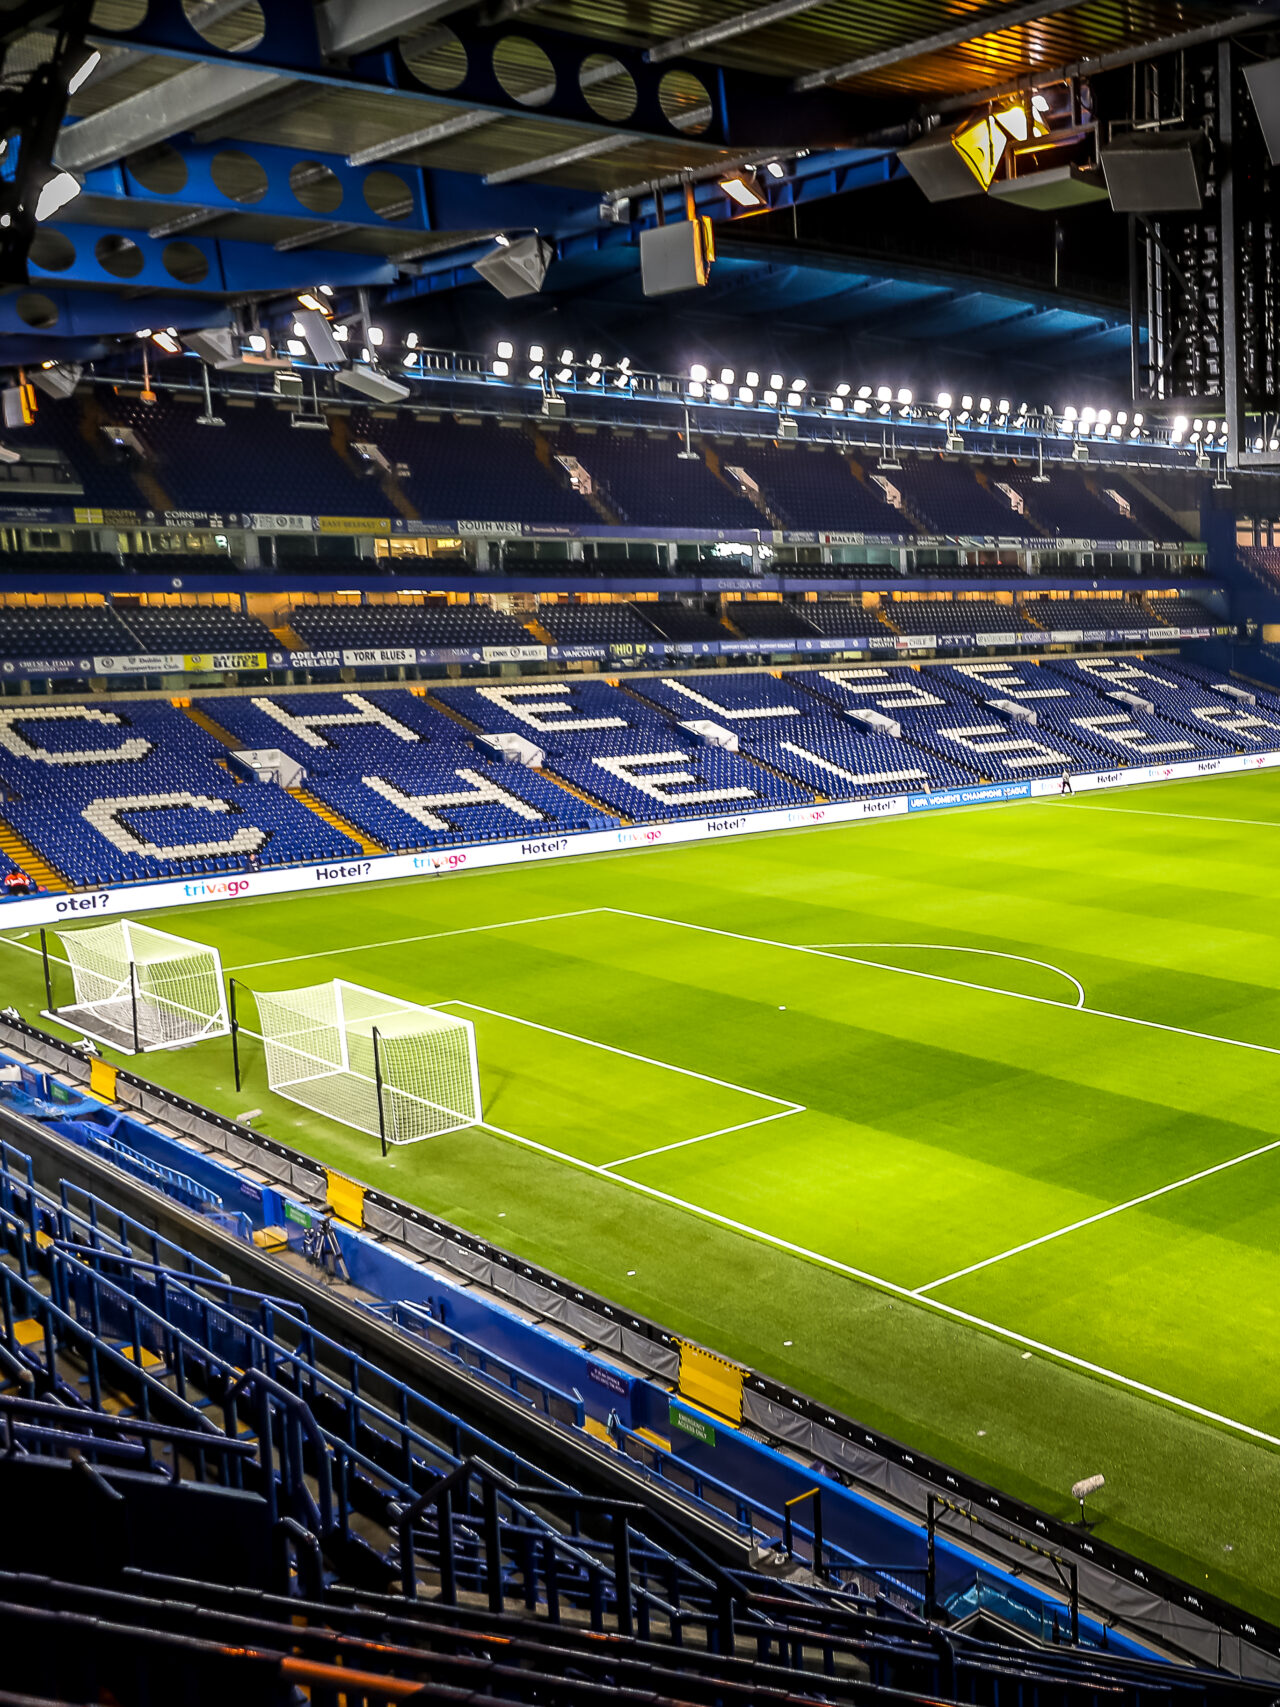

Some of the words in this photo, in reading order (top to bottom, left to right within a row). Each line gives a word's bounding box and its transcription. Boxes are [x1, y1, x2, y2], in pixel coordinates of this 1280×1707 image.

[164, 511, 208, 519] CORNISH
[165, 519, 195, 528] BLUES
[459, 520, 492, 531] SOUTH
[495, 521, 521, 532] WEST
[831, 535, 856, 543] MALTA
[289, 651, 341, 660] ADELAIDE
[353, 651, 377, 661] YORK
[380, 650, 407, 661] BLUES
[562, 649, 606, 658] VANCOUVER
[610, 643, 633, 655] OHIO
[213, 654, 259, 662] SAFFRON
[213, 660, 260, 669] BLUES
[292, 659, 340, 668] CHELSEA
[911, 796, 929, 808] UEFA
[930, 793, 962, 806] WOMEN'S
[961, 788, 1003, 803] CHAMPIONS
[863, 799, 897, 814] Hotel?
[707, 816, 748, 833] Hotel?
[617, 828, 663, 845] trivago
[521, 838, 569, 856] Hotel?
[413, 852, 467, 871] trivago
[316, 862, 373, 882] Hotel?
[184, 877, 250, 898] trivago
[56, 893, 110, 914] otel?
[678, 1412, 705, 1432] EMERGENCY
[677, 1420, 695, 1434] ACCESS
[696, 1428, 707, 1440] ONLY
